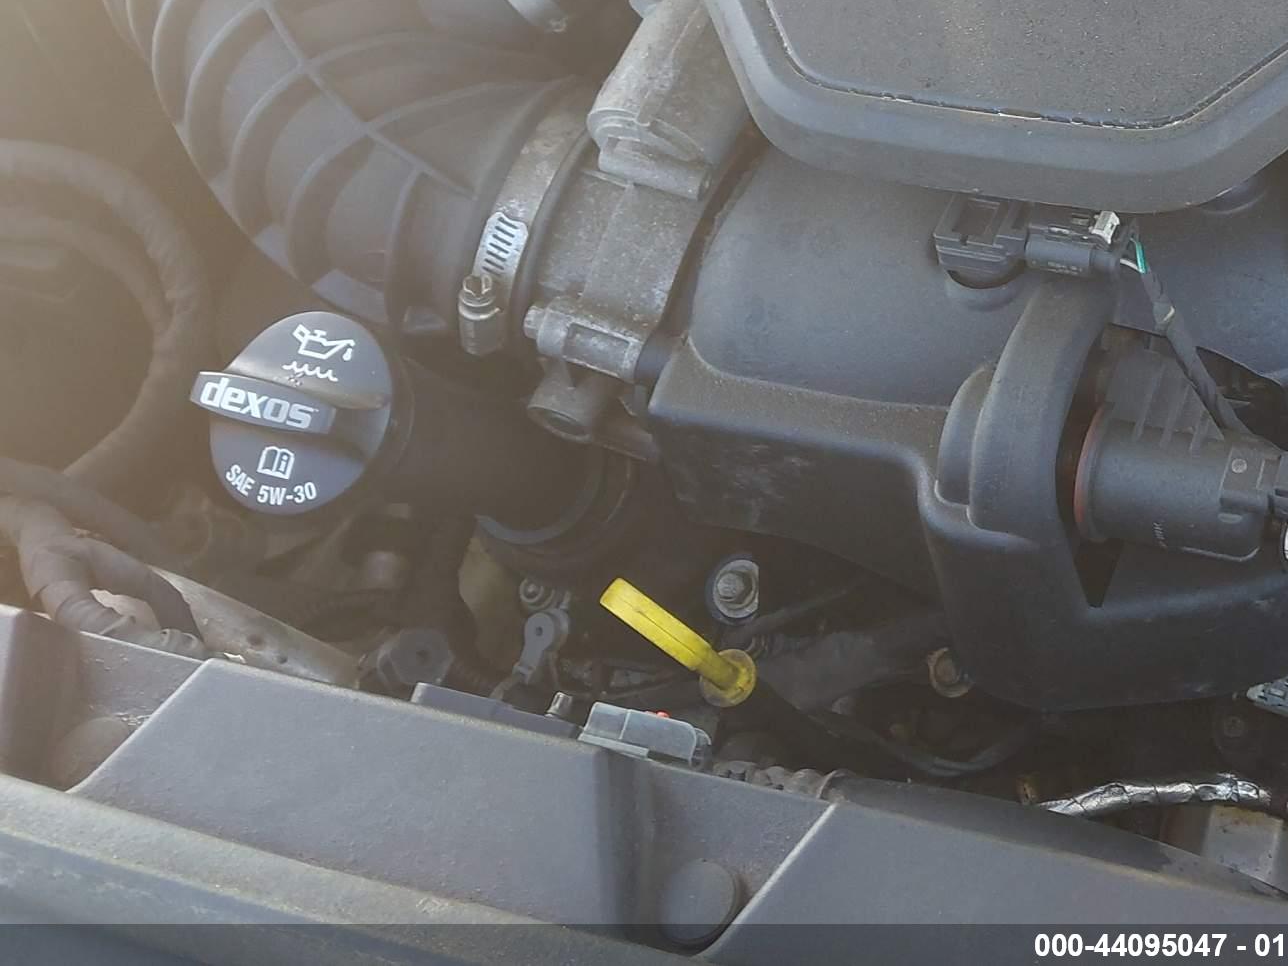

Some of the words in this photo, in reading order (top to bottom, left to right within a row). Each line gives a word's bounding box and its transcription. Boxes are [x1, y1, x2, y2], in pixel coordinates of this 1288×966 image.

[200, 378, 314, 430] dexos
[225, 464, 256, 497] SAE
[257, 481, 317, 506] 5W-30
